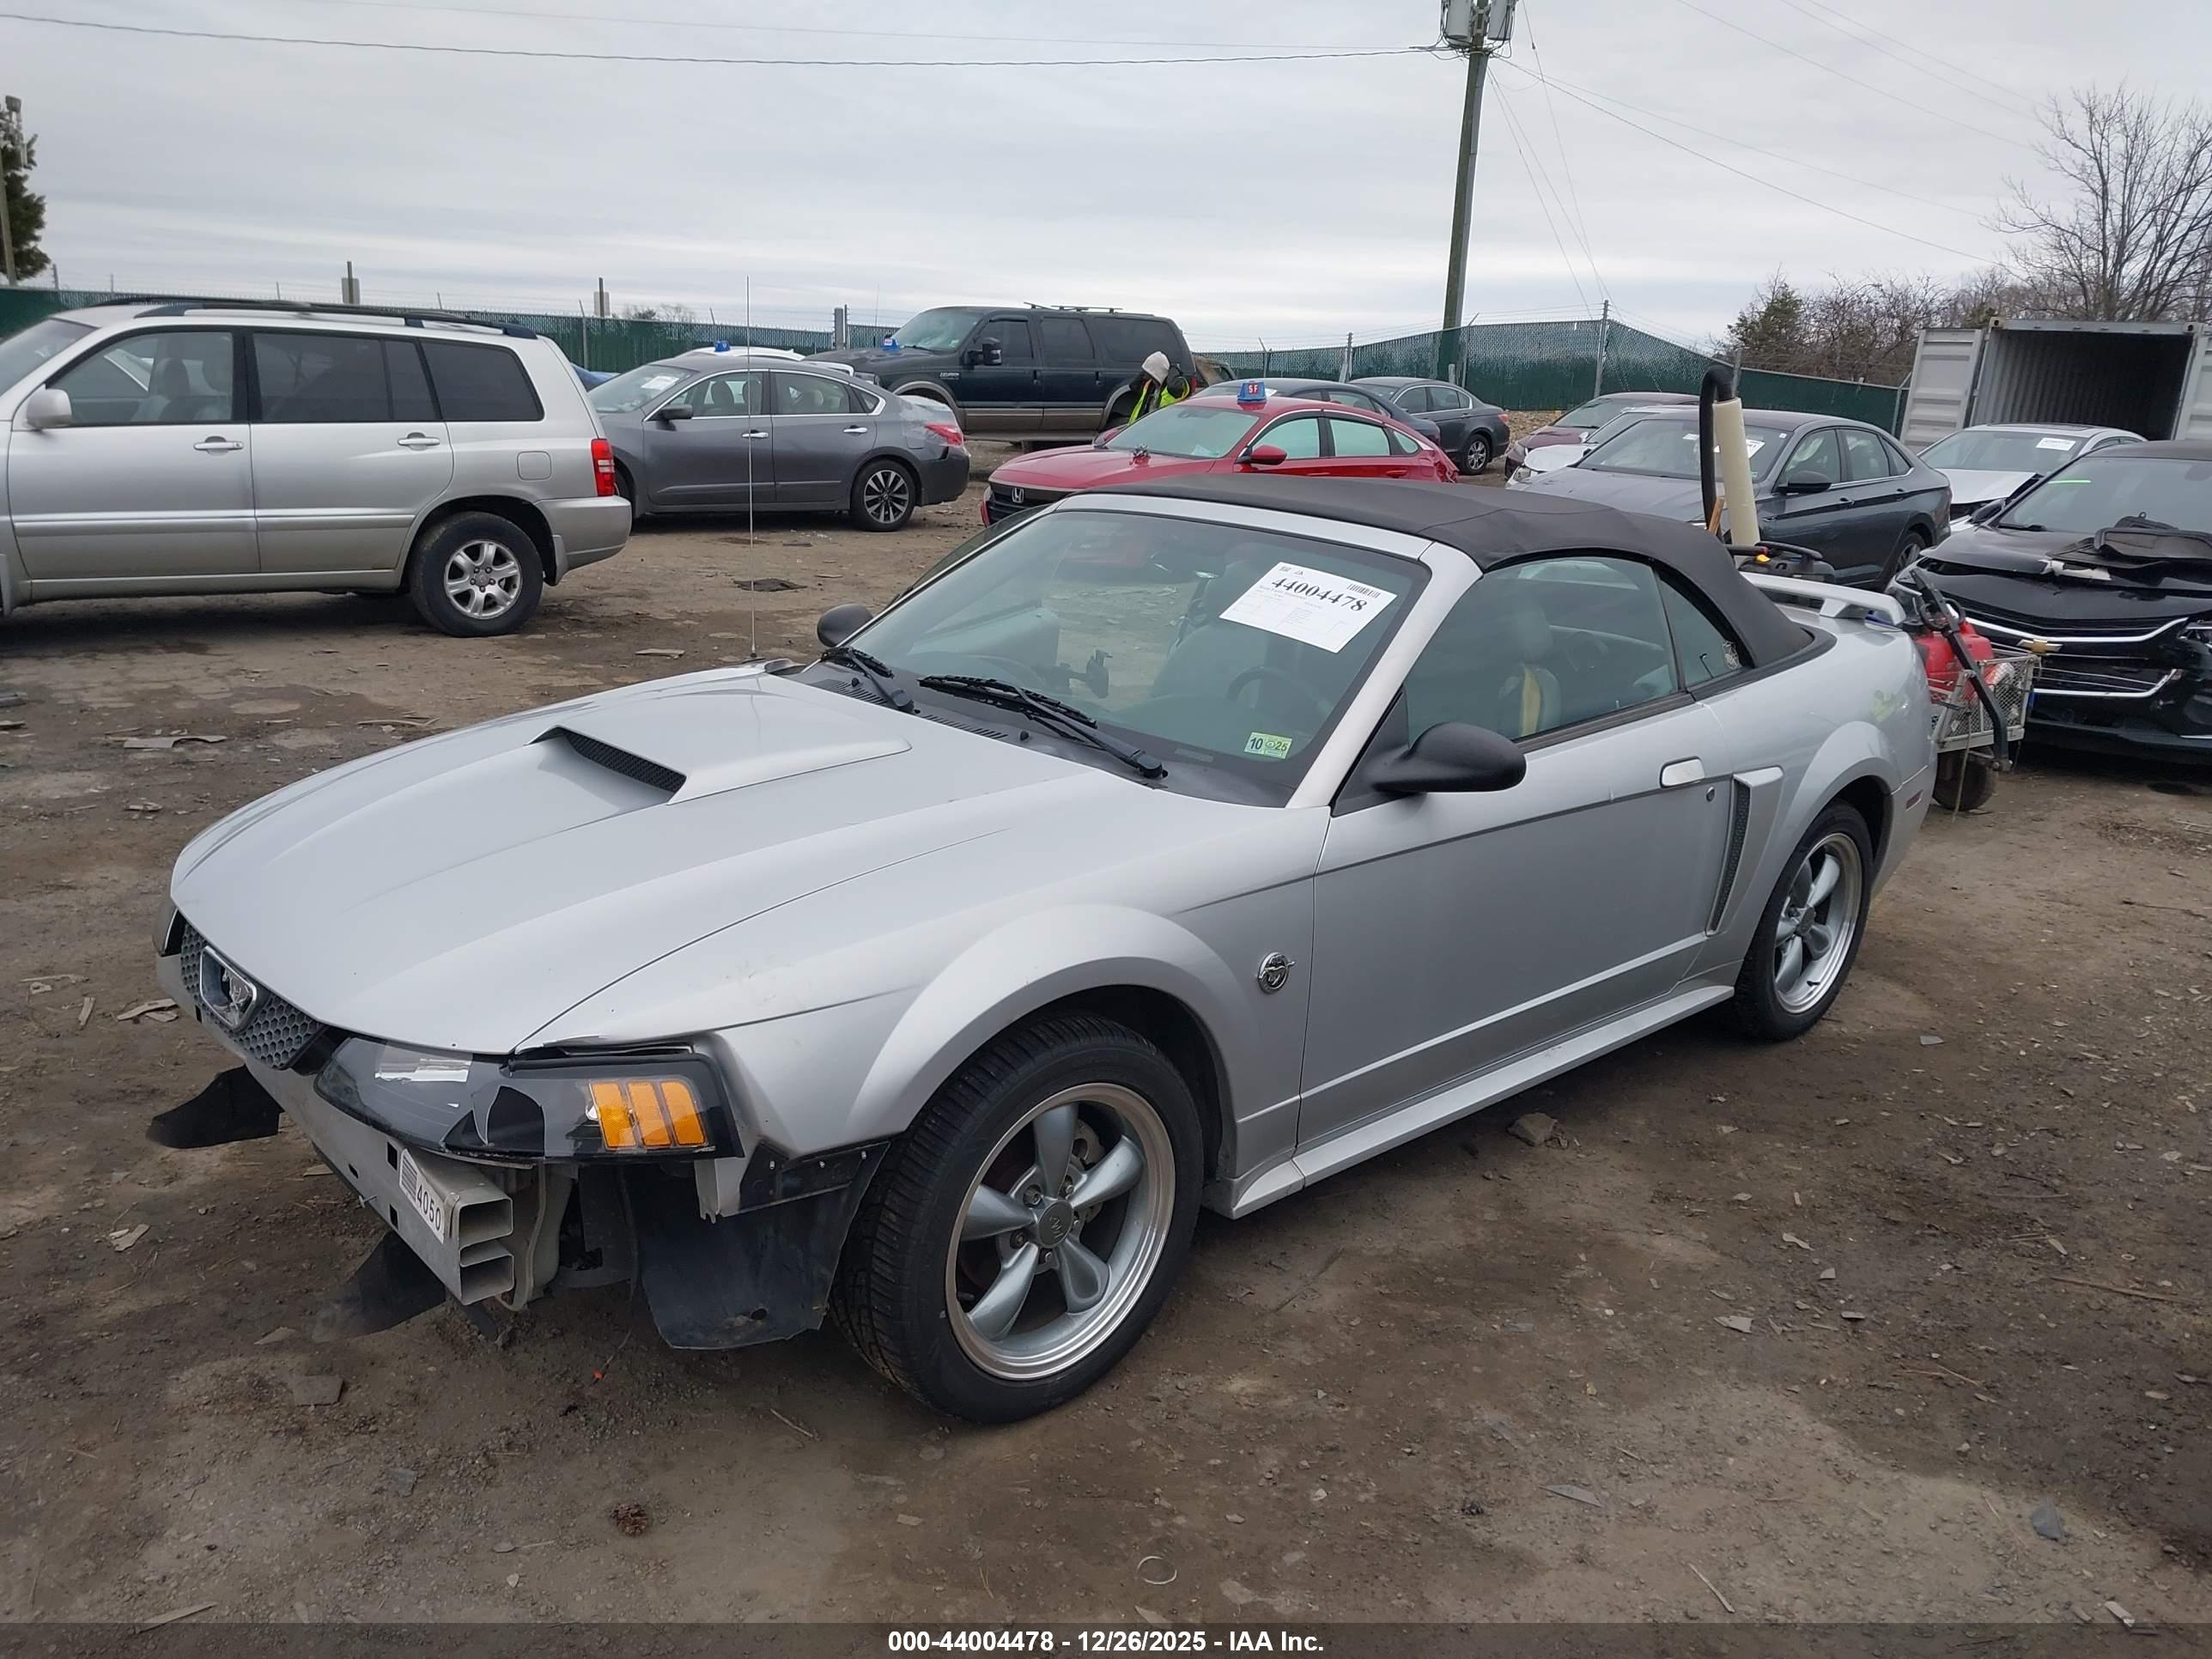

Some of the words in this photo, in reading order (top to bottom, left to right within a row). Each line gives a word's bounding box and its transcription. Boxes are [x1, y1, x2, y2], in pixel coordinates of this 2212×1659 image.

[1272, 577, 1368, 611] 44004478
[1250, 737, 1263, 750] 10
[1274, 741, 1288, 751] 25
[416, 1184, 441, 1231] 4050
